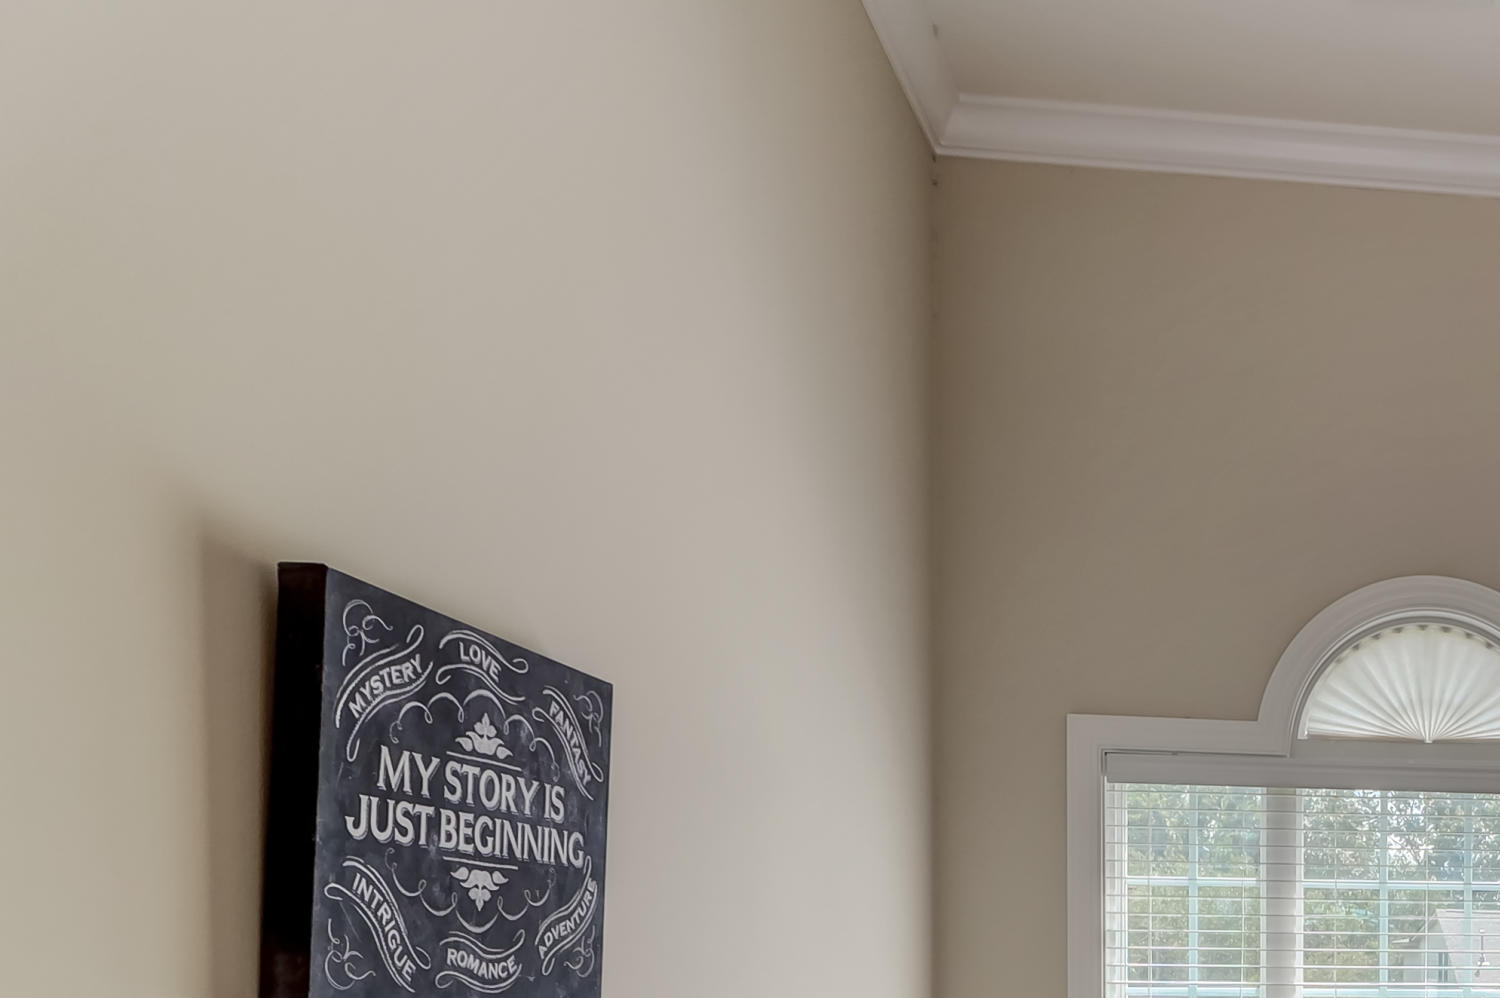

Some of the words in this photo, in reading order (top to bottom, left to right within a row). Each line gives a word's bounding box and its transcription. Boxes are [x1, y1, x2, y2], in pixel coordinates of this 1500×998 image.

[348, 653, 422, 719] MYSTERY
[459, 641, 502, 683] LOVE
[550, 700, 592, 786] FANTASY
[377, 744, 440, 799] MY
[444, 760, 540, 818] STORY
[543, 783, 567, 824] IS
[344, 794, 435, 849] JUST
[438, 808, 586, 870] BEGINNING
[352, 873, 416, 983] INTRIGUE
[538, 877, 597, 960] ADVENTURE
[447, 947, 518, 980] ROMANCE
